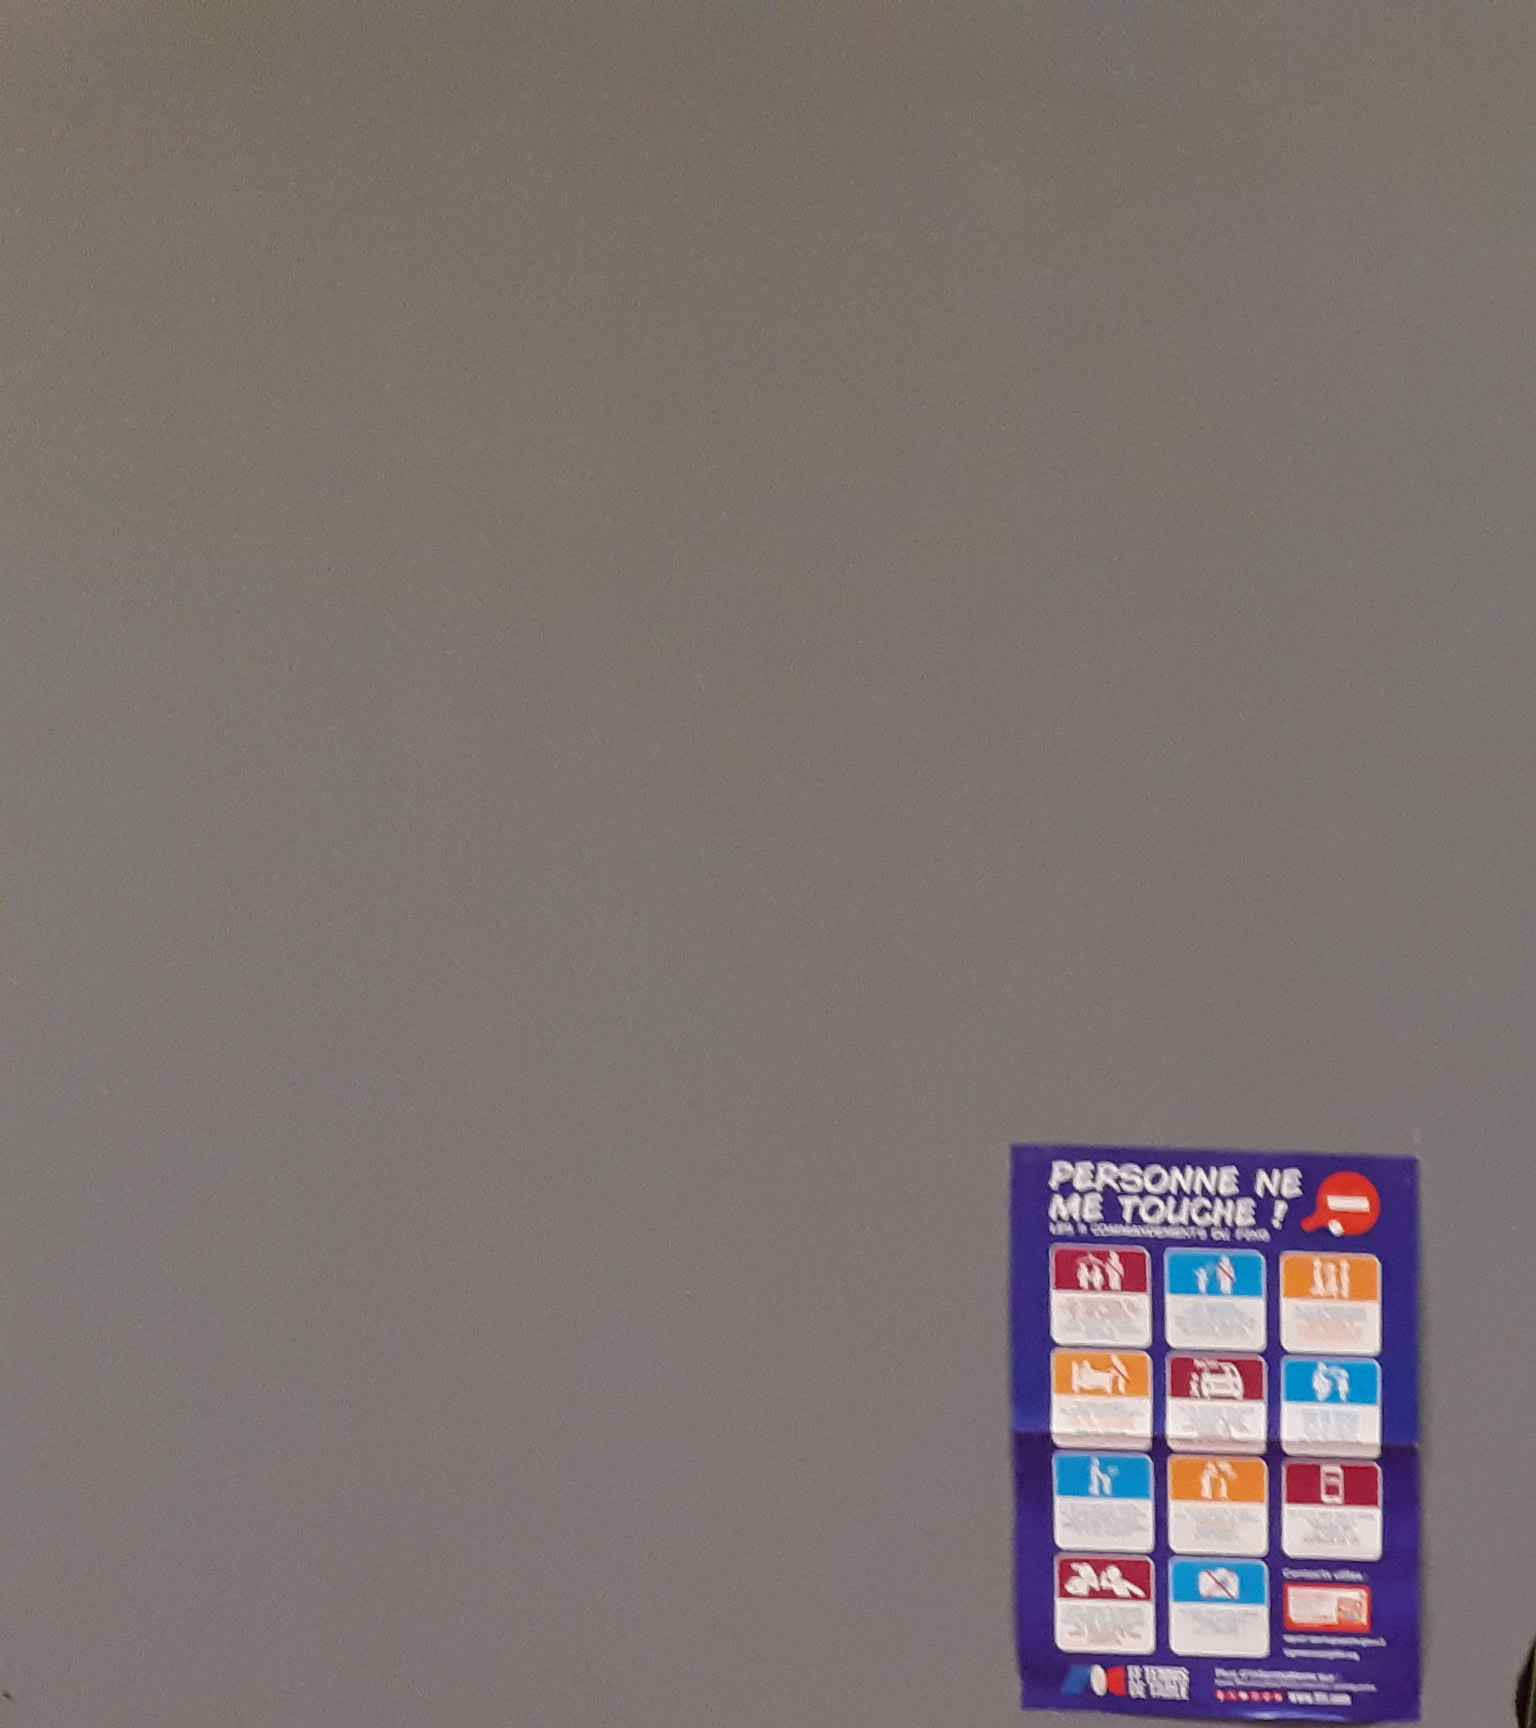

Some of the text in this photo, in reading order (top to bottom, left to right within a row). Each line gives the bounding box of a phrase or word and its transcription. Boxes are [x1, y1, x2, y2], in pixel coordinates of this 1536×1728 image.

[1048, 1160, 1304, 1198] PERSONNE NE
[1048, 1193, 1289, 1230] ME TOUCHE !
